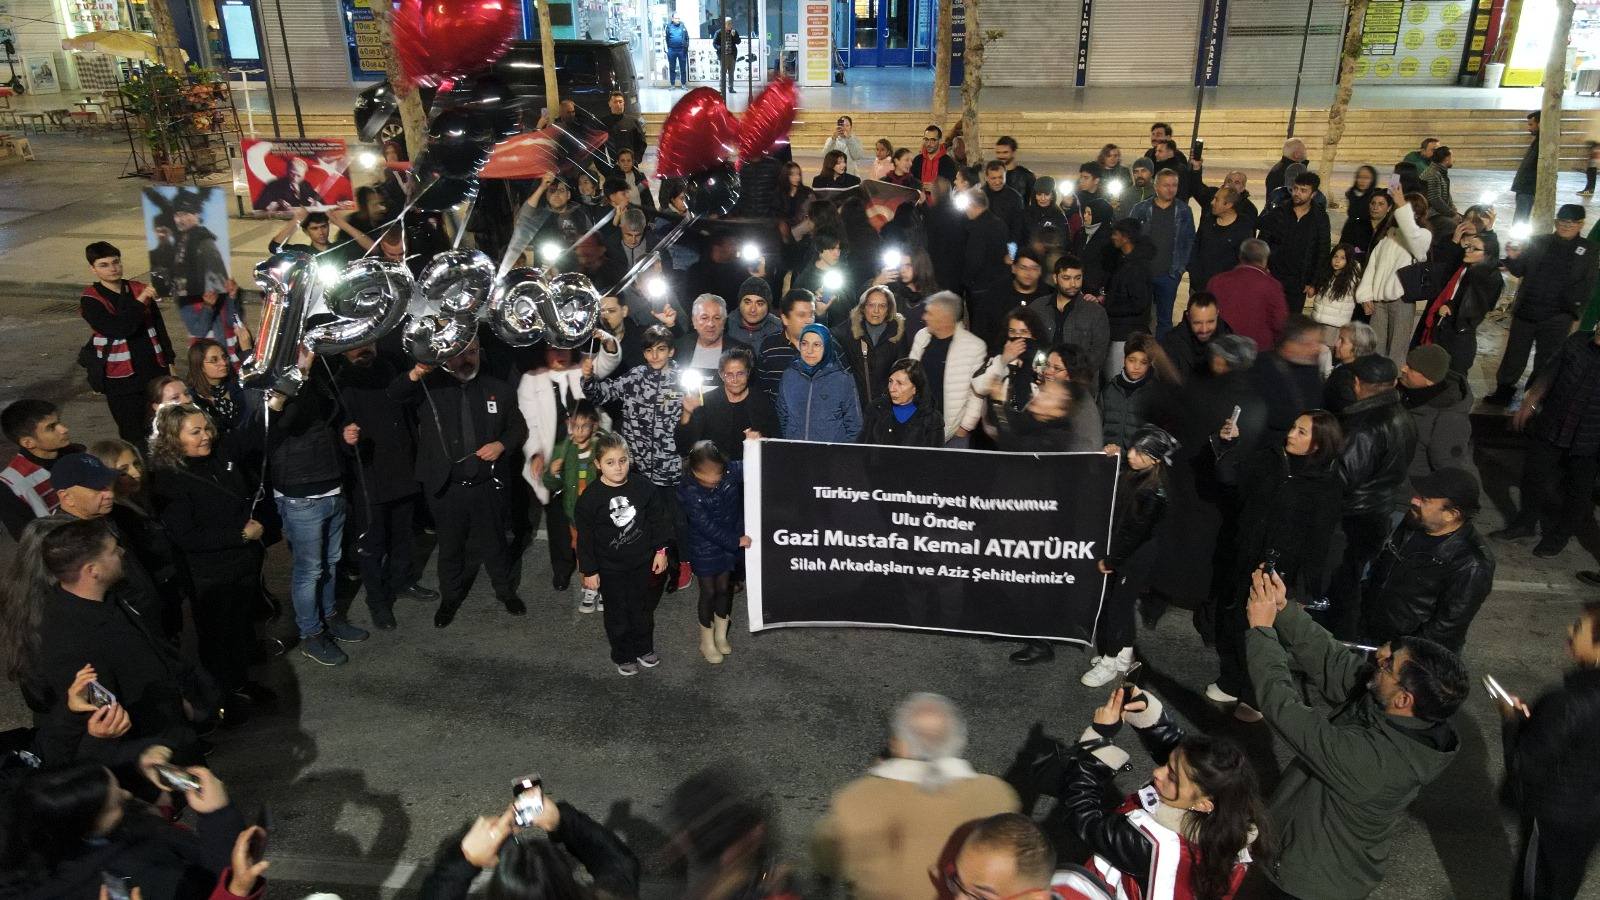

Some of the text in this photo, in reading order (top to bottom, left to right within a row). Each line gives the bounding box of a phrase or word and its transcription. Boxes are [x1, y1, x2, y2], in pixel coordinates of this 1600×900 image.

[813, 486, 1059, 512] Türkiye Cumhuriyeti Kurucumuz
[891, 511, 977, 532] Ulu Önder
[773, 528, 1097, 560] Gazi Mustafa Kemal ATATÜRK
[790, 557, 1076, 585] Silah Arkadaşları ve Aziz Şehitlerimiz'e
